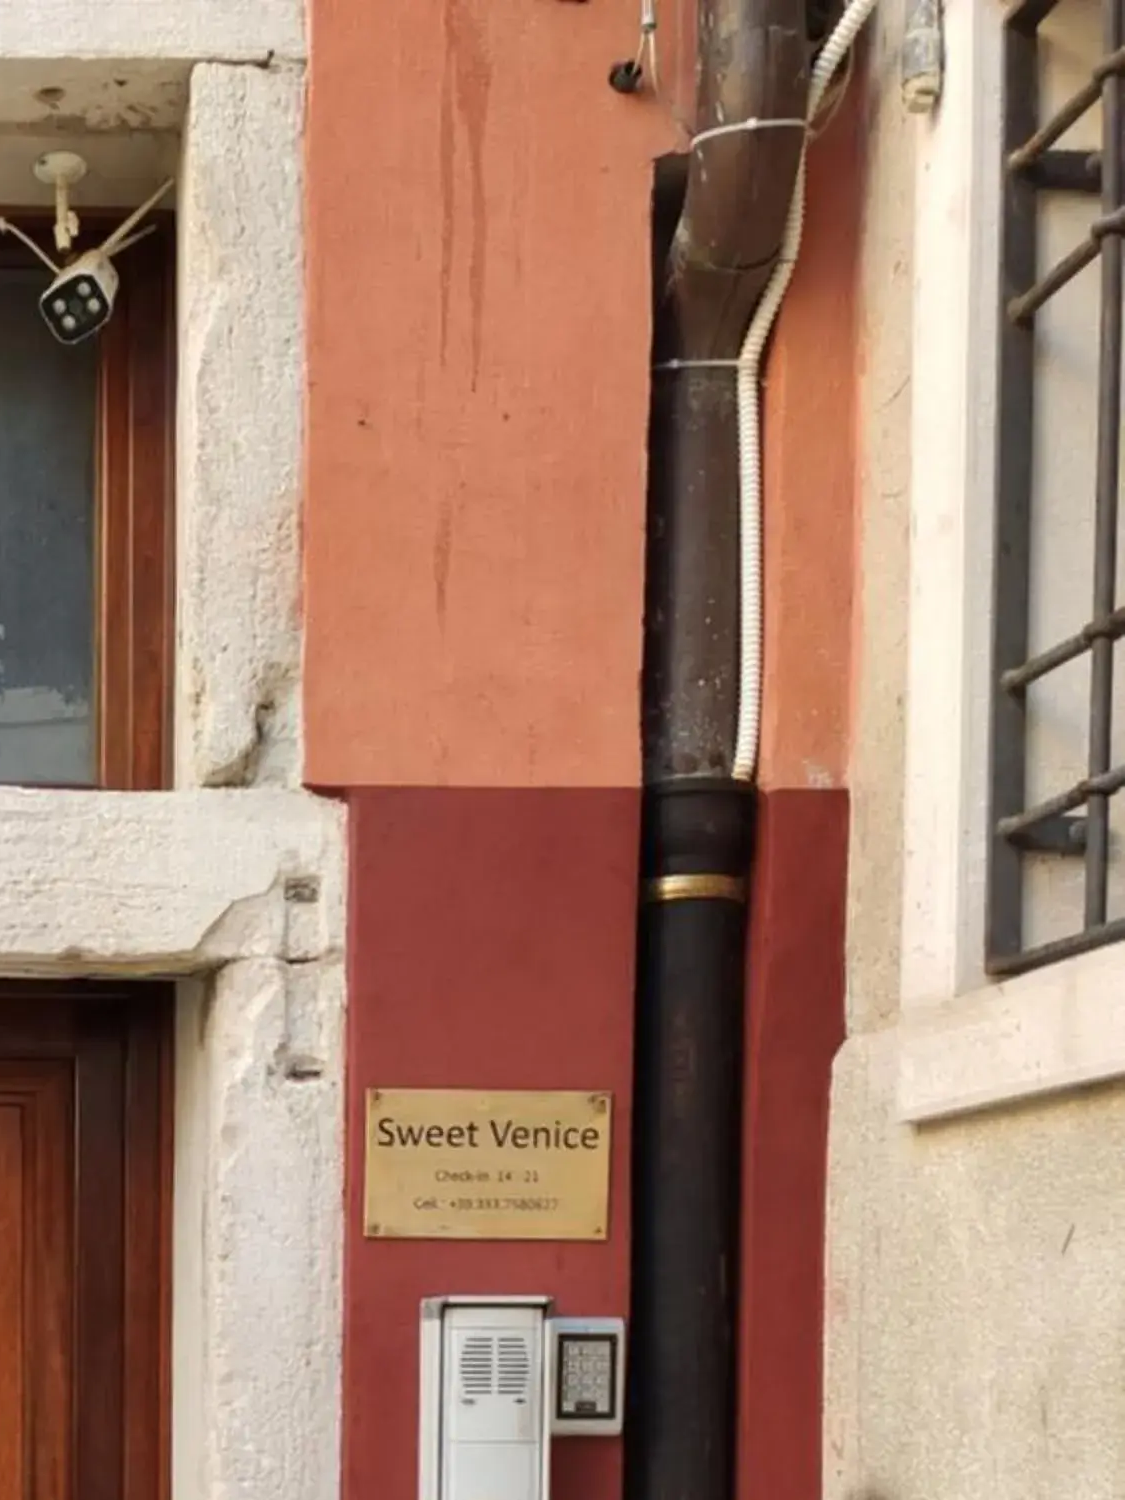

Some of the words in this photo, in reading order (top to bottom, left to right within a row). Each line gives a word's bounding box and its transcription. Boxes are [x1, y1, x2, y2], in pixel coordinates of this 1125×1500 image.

[377, 1117, 480, 1148] Sweet
[489, 1118, 600, 1150] Venice
[435, 1169, 490, 1183] Check-in
